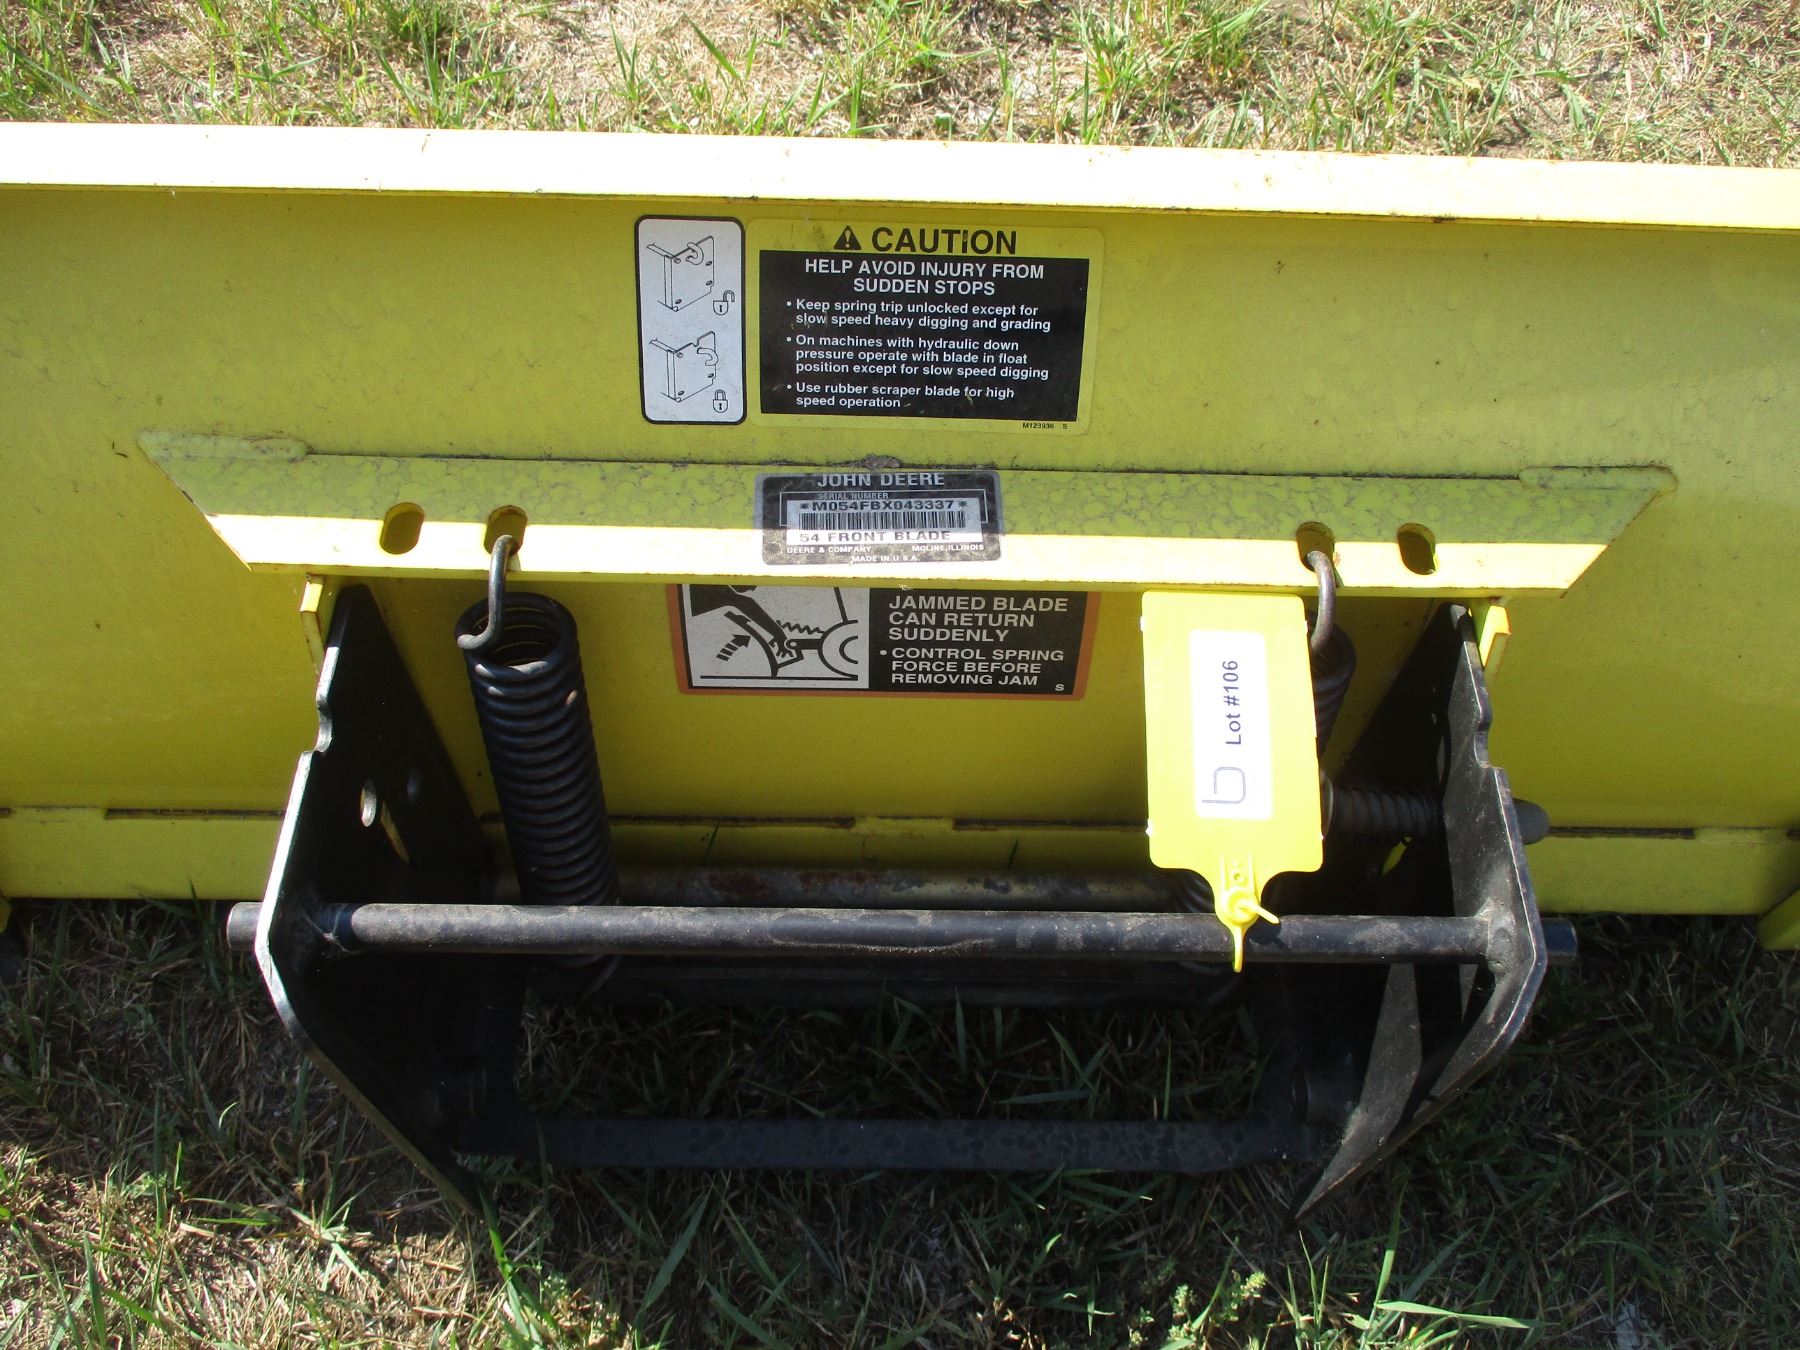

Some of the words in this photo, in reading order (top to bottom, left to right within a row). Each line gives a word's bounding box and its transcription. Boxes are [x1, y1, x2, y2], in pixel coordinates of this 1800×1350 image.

[871, 228, 1017, 254] CAUTION
[805, 259, 853, 274] HELP
[858, 261, 916, 276] AVOID
[920, 261, 987, 277] INJURY
[992, 263, 1044, 279] FROM
[853, 278, 930, 294] SUDDEN
[935, 280, 995, 295] STOPS
[796, 299, 830, 312] Keep
[834, 301, 876, 314] spring
[880, 301, 903, 314] trip
[907, 302, 968, 313] unlocked
[972, 304, 1014, 316] except
[1018, 304, 1038, 315] for
[795, 312, 826, 325] slow
[831, 314, 871, 328] speed
[874, 315, 914, 329] heavy
[918, 316, 968, 330] digging
[972, 317, 997, 328] and
[1001, 318, 1051, 332] grading
[796, 334, 816, 347] On
[820, 335, 882, 348] machines
[886, 336, 914, 348] with
[918, 338, 979, 352] hydraulic
[983, 338, 1019, 350] down
[796, 350, 854, 363] pressure
[858, 350, 909, 364] operate
[912, 350, 939, 362] with
[943, 351, 979, 362] blade
[983, 352, 995, 363] in
[998, 352, 1027, 364] float
[796, 361, 849, 375] position
[852, 364, 895, 377] except
[899, 364, 919, 375] for
[923, 364, 953, 376] slow
[957, 365, 996, 379] speed
[1000, 366, 1049, 380] digging
[796, 383, 821, 394] Use
[825, 383, 868, 395] rubber
[871, 385, 922, 398] scraper
[925, 384, 961, 396] blade
[965, 386, 983, 397] for
[986, 386, 1015, 399] high
[796, 395, 835, 409] speed
[839, 396, 900, 409] operation
[818, 473, 871, 487] JOHN
[880, 473, 945, 486] DEERE
[800, 533, 819, 543] 54
[828, 532, 887, 542] FRONT
[894, 531, 950, 541] BLADE
[889, 596, 986, 611] JAMMED
[992, 597, 1068, 612] BLADE
[889, 612, 935, 627] CAN
[944, 613, 1034, 627] RETURN
[889, 627, 1009, 642] SUDDENLY
[892, 648, 987, 661] CONTROL
[991, 648, 1064, 662] SPRING
[892, 661, 957, 674] FORCE
[964, 661, 1041, 674] BEFORE
[892, 674, 994, 686] REMOVING
[998, 675, 1037, 686] JAM
[1222, 660, 1240, 707] #106
[1226, 714, 1242, 745] Lot
